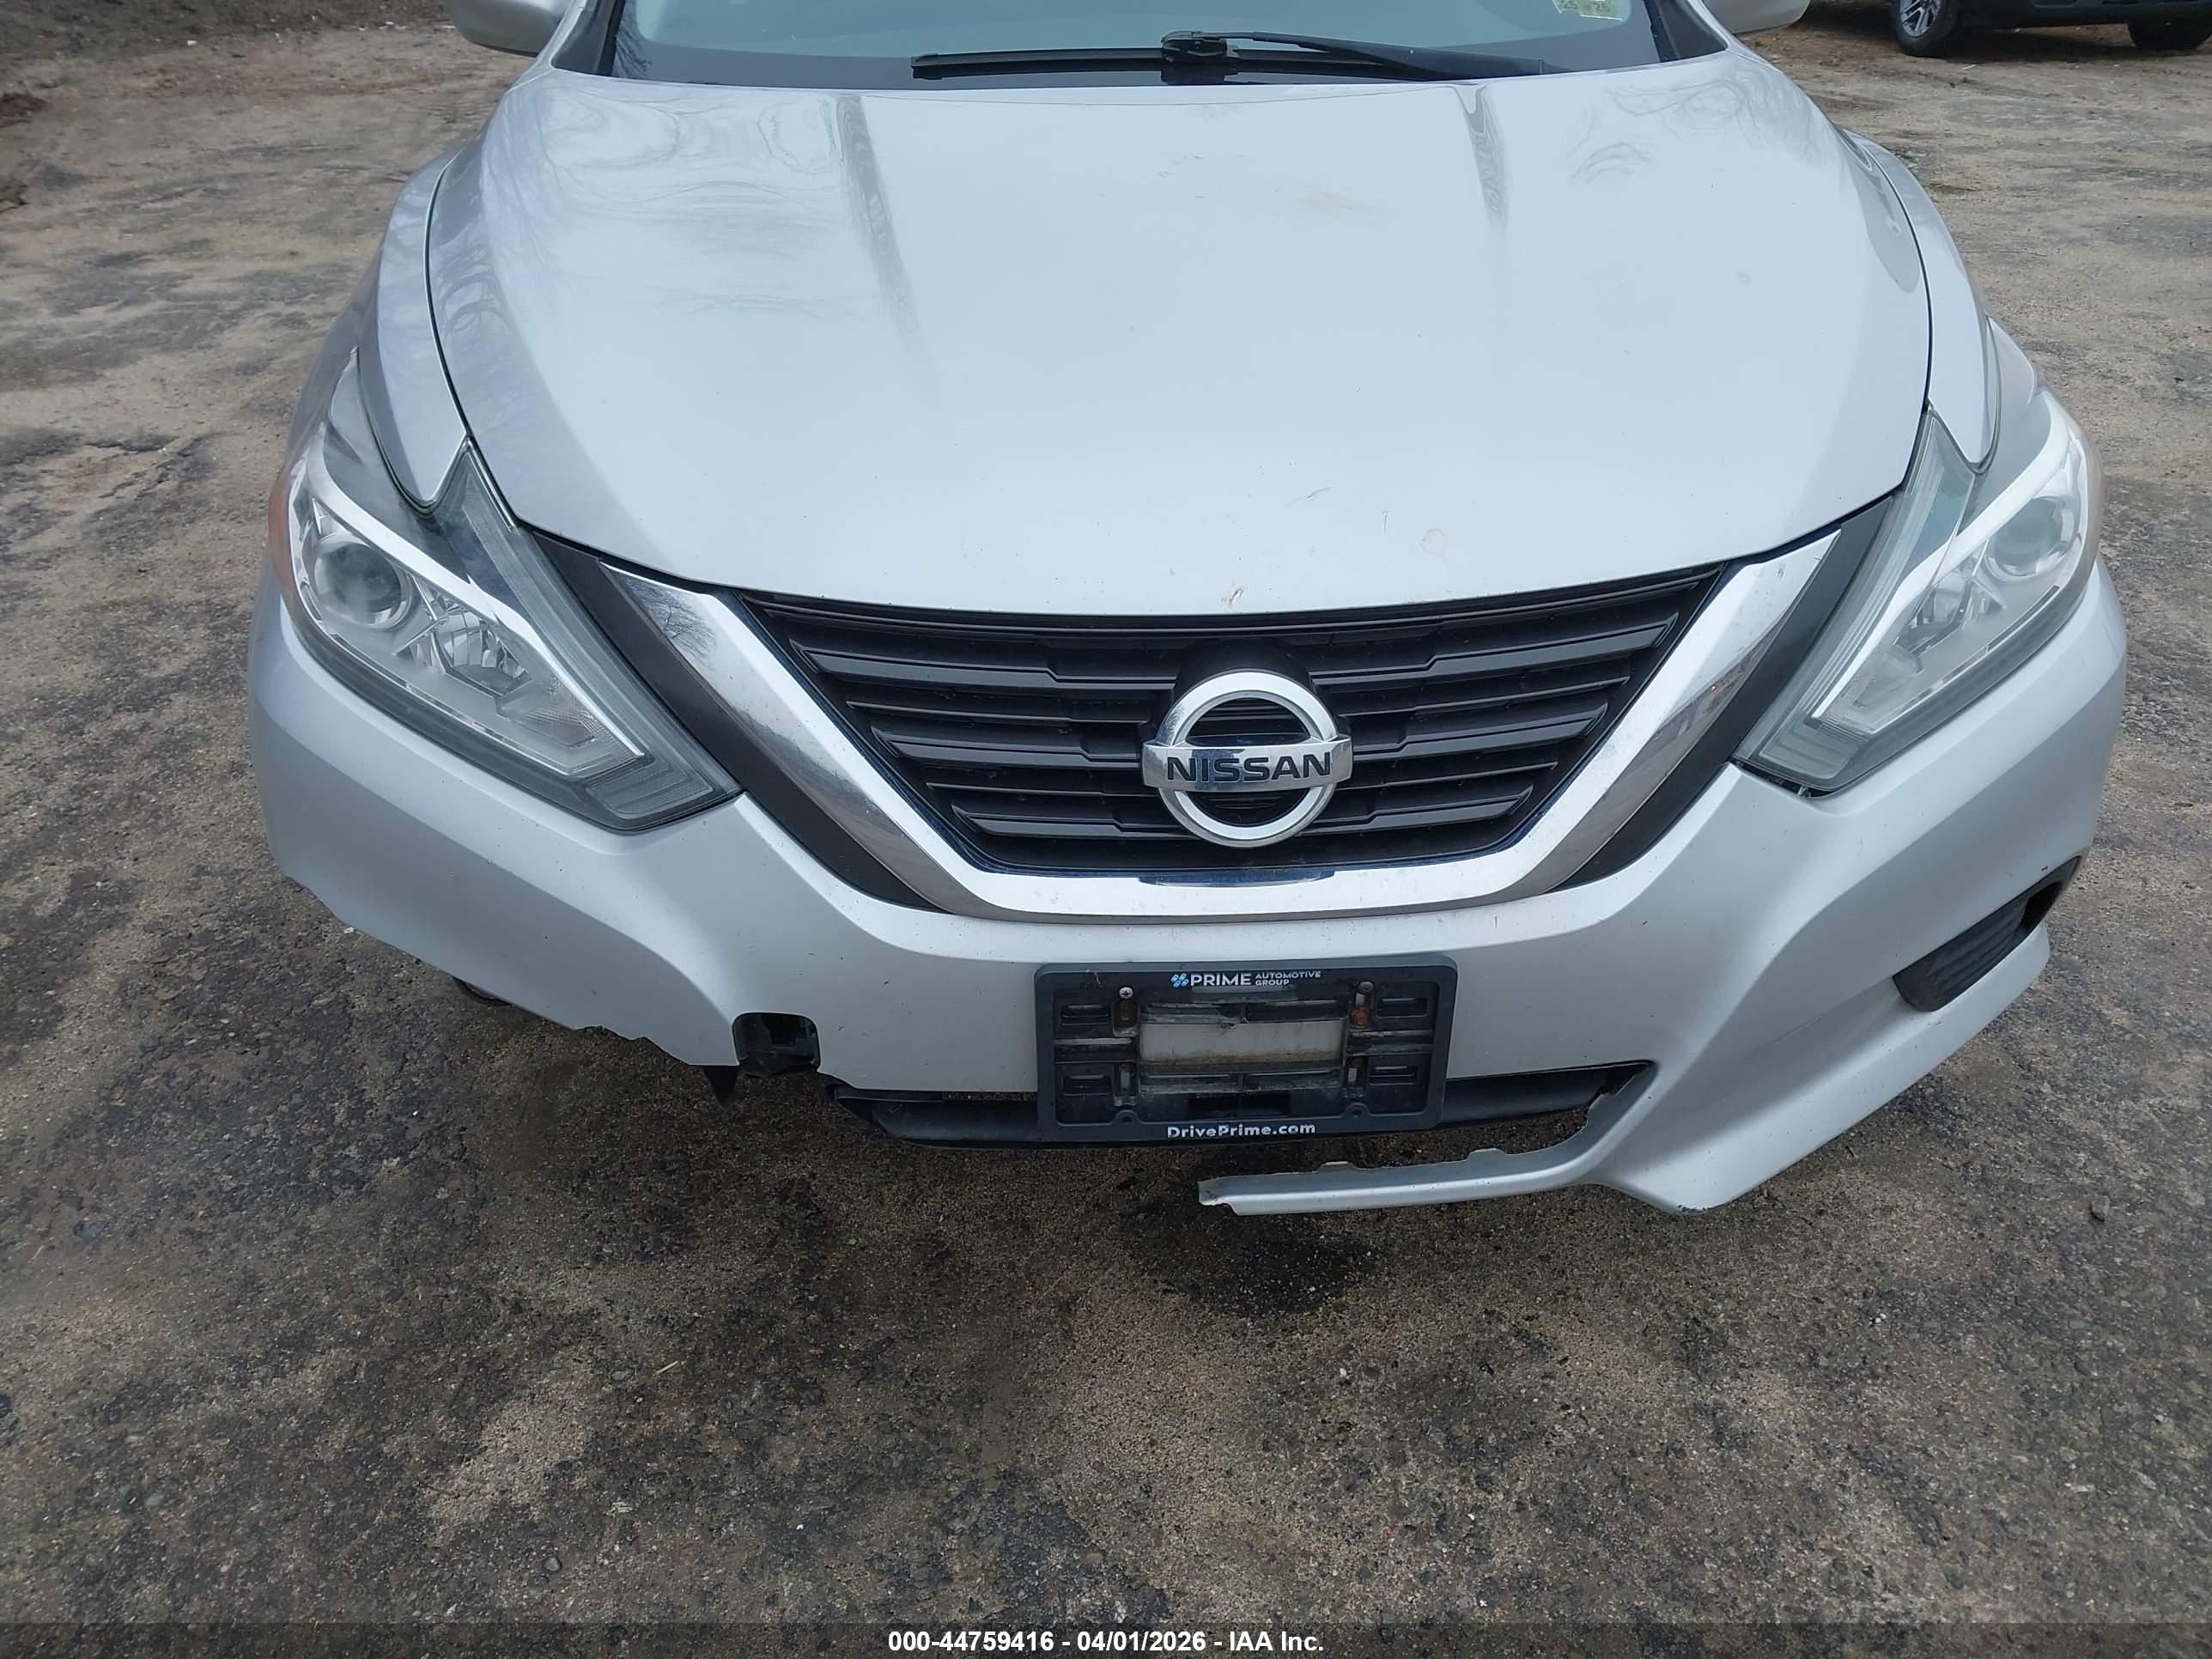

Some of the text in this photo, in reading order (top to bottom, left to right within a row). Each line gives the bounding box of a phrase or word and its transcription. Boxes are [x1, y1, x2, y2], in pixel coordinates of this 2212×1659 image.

[1166, 751, 1331, 782] NISSAN
[1190, 973, 1252, 987] PRIME
[1255, 970, 1322, 980] AUTOMOTIVE
[1167, 1123, 1316, 1139] DrivePrime.com
